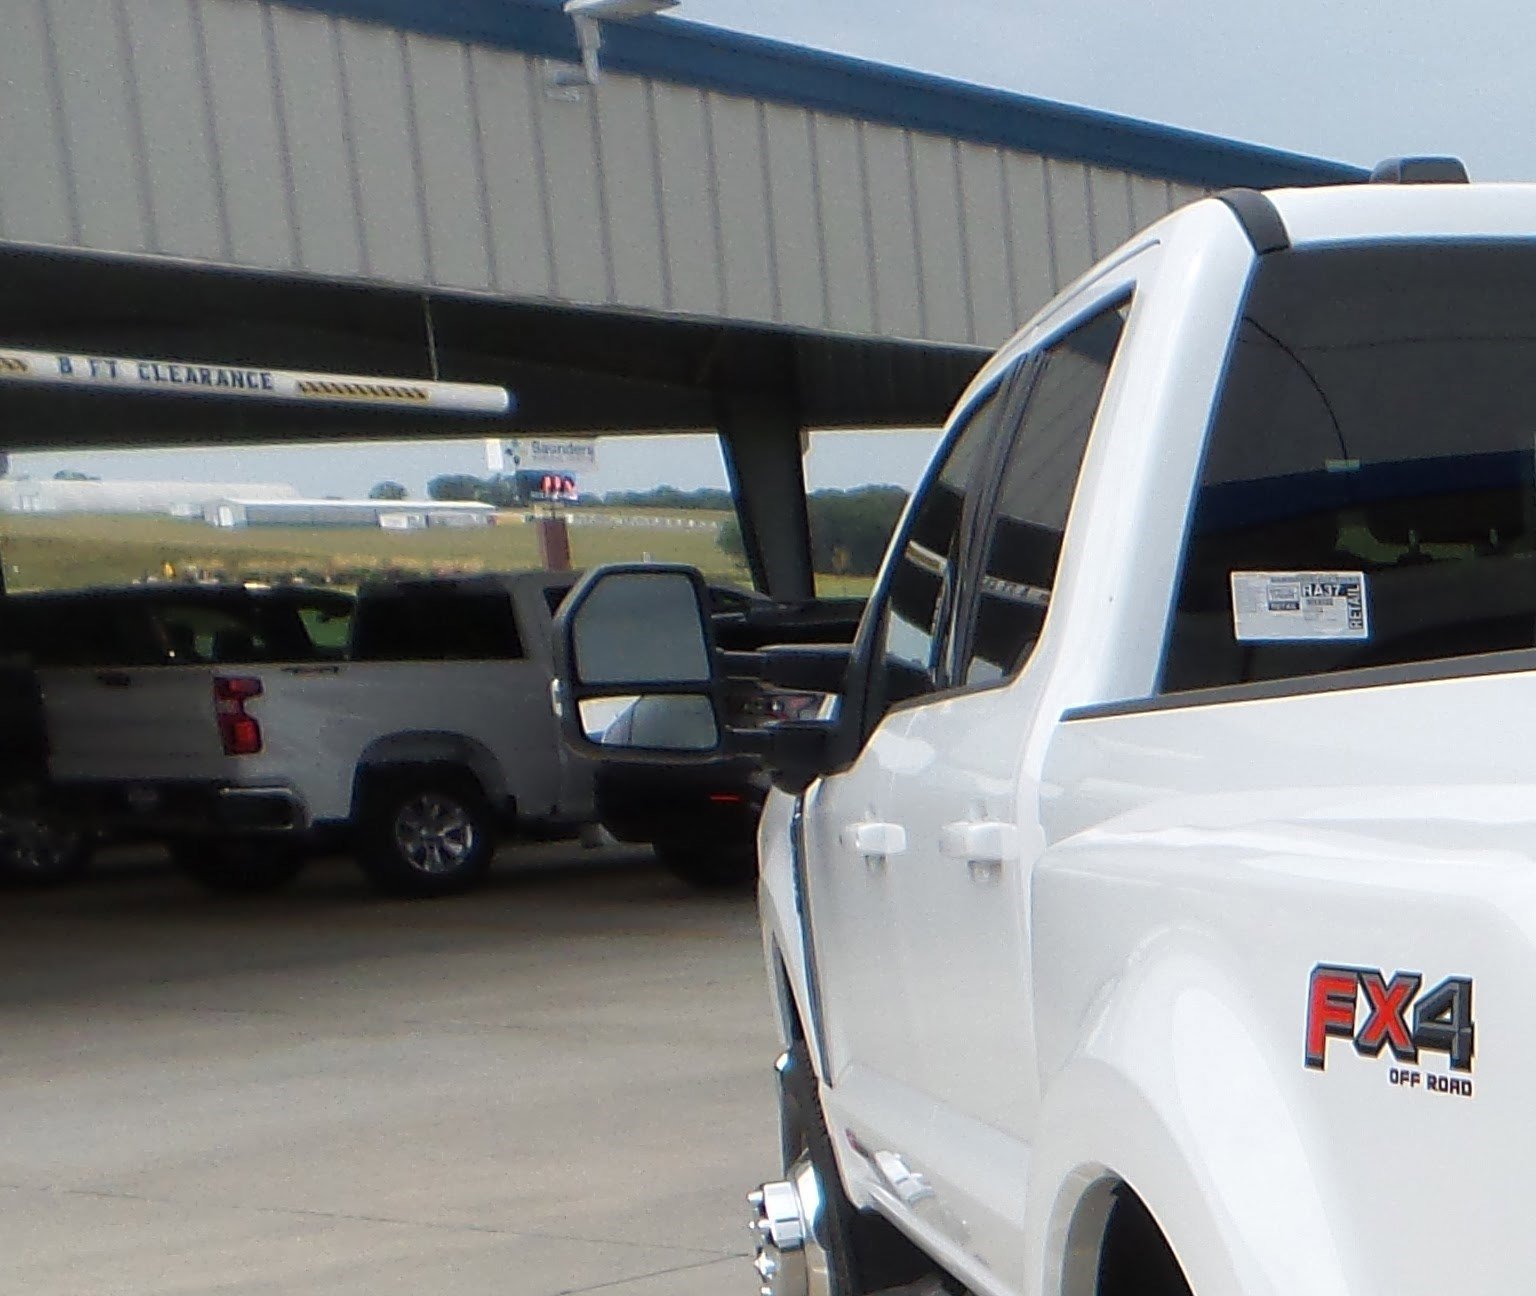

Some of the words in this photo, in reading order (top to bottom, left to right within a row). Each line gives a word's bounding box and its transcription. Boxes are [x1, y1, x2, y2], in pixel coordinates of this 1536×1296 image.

[89, 358, 118, 379] FT
[137, 362, 273, 390] CLEARANCE
[1347, 584, 1363, 629] RETAIL
[1304, 962, 1474, 1073] FX4
[1389, 1068, 1420, 1087] OFF
[1427, 1073, 1472, 1097] ROAD
